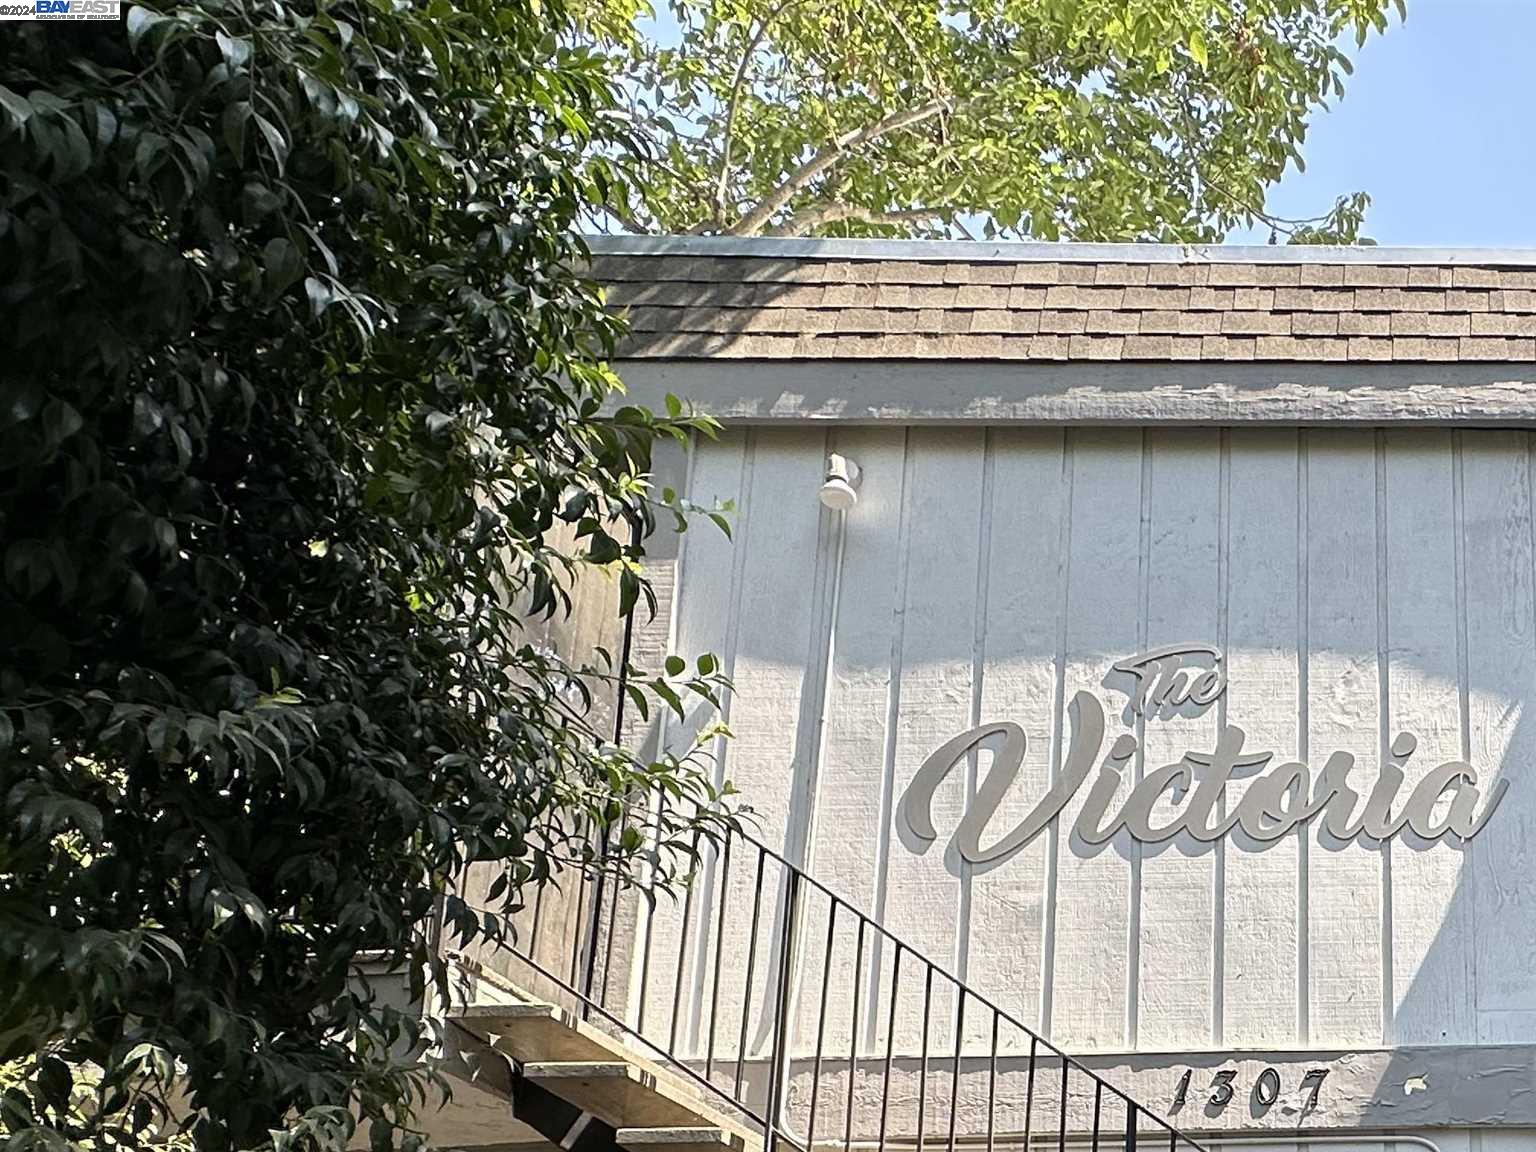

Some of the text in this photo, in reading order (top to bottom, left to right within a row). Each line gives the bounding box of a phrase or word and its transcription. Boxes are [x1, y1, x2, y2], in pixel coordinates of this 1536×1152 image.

[1113, 643, 1229, 713] The
[903, 690, 1511, 864] Victoria
[1173, 1067, 1331, 1109] 1307
